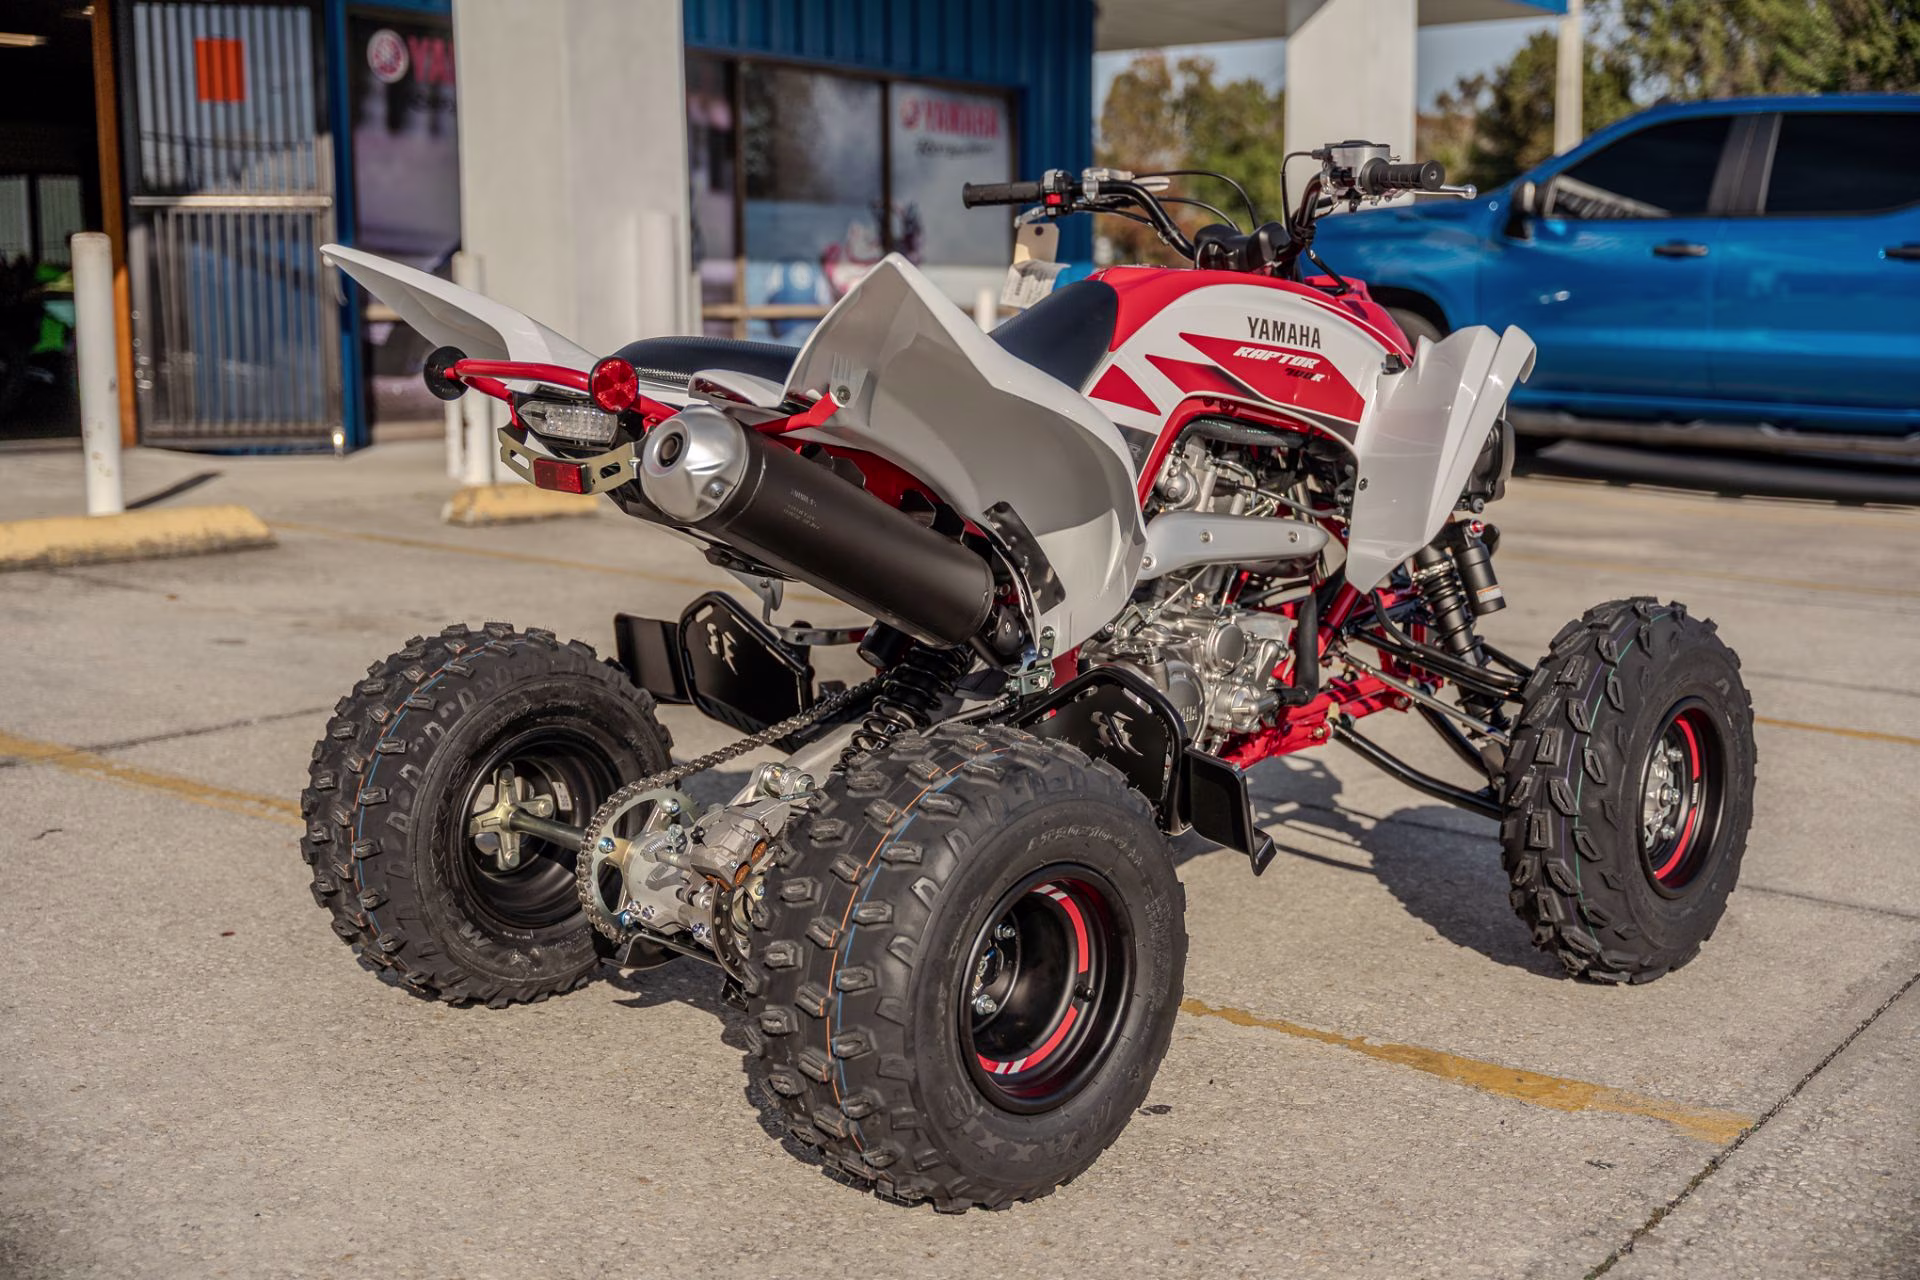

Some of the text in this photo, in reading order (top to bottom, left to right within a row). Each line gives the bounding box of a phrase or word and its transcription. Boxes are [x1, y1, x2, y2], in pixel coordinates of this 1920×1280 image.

[1247, 316, 1321, 349] YAMAHA
[1233, 346, 1320, 369] RAPTOR
[1285, 368, 1325, 382] 700R
